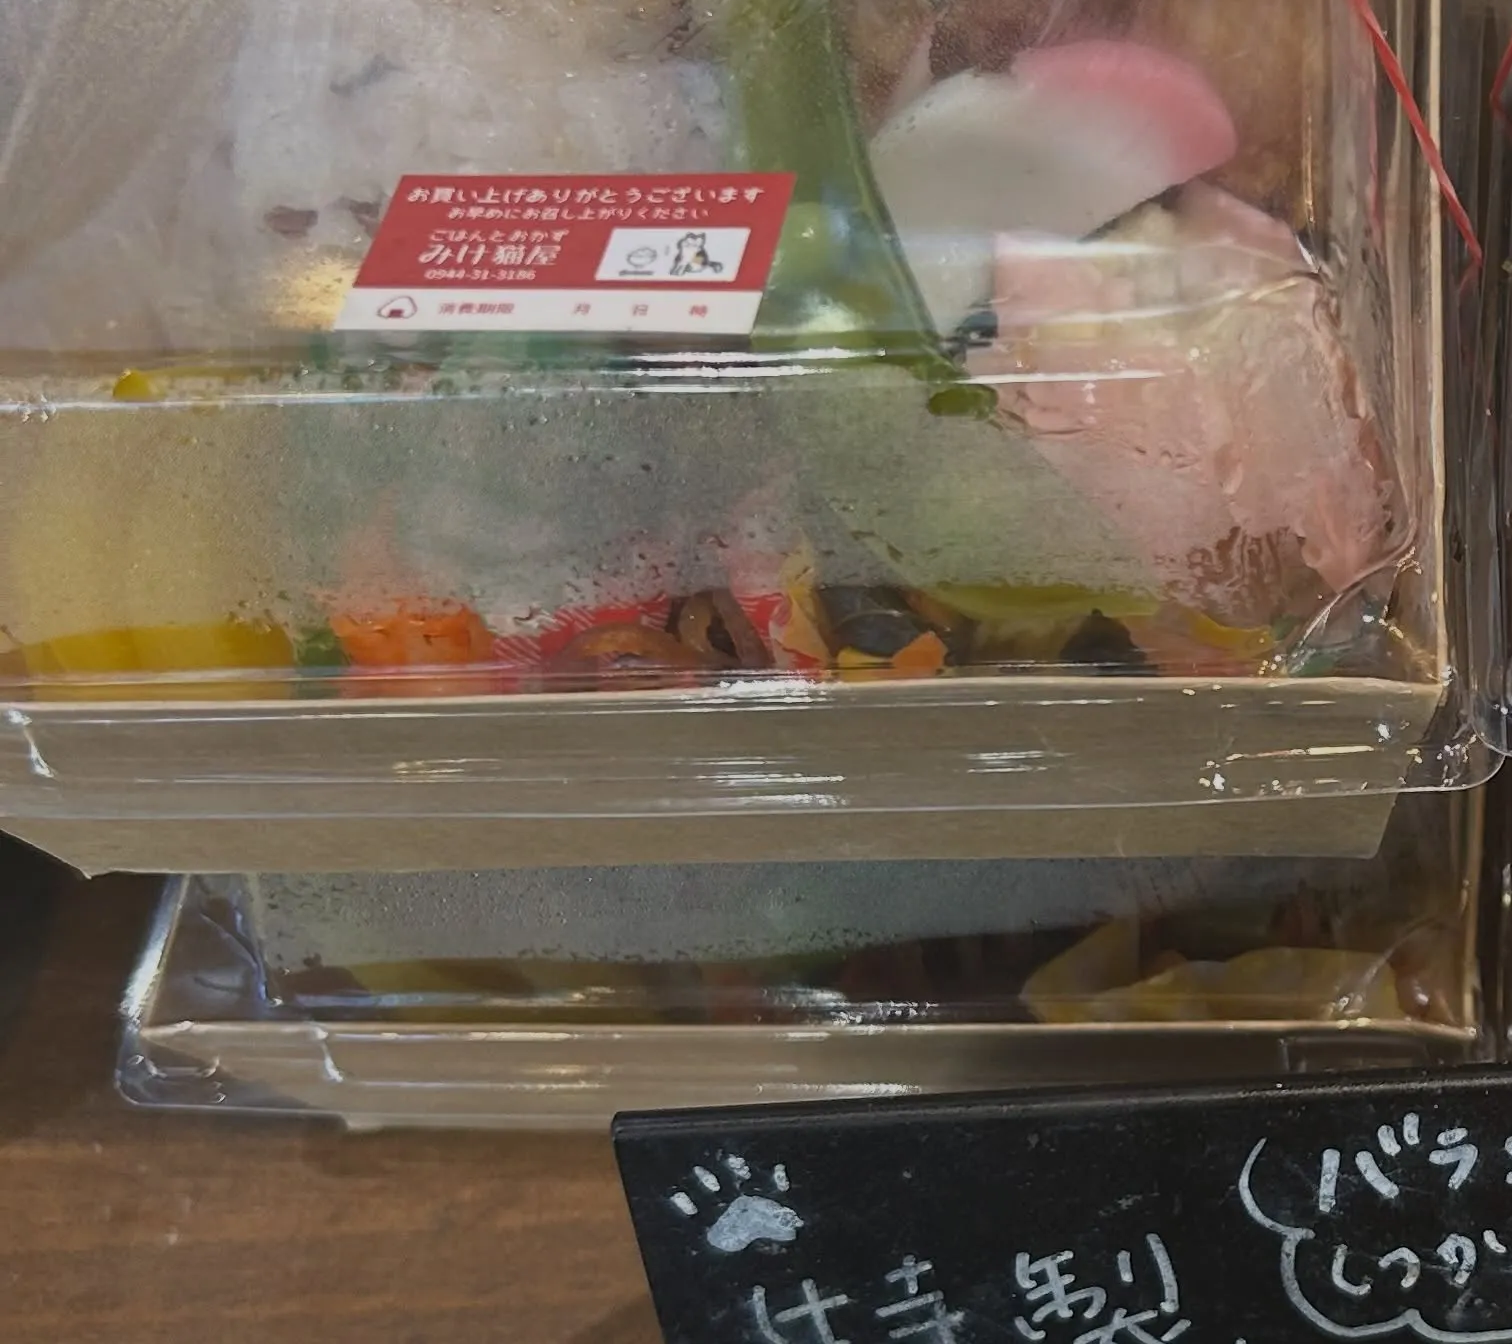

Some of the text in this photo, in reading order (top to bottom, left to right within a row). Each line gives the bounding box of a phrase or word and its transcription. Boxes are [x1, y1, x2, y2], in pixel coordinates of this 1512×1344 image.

[407, 186, 765, 204] お買い上げありがとうございます
[448, 207, 709, 220] お早めにお召し上がりください
[430, 229, 570, 242] ごはんとおかず
[418, 244, 562, 265] みけ猫屋
